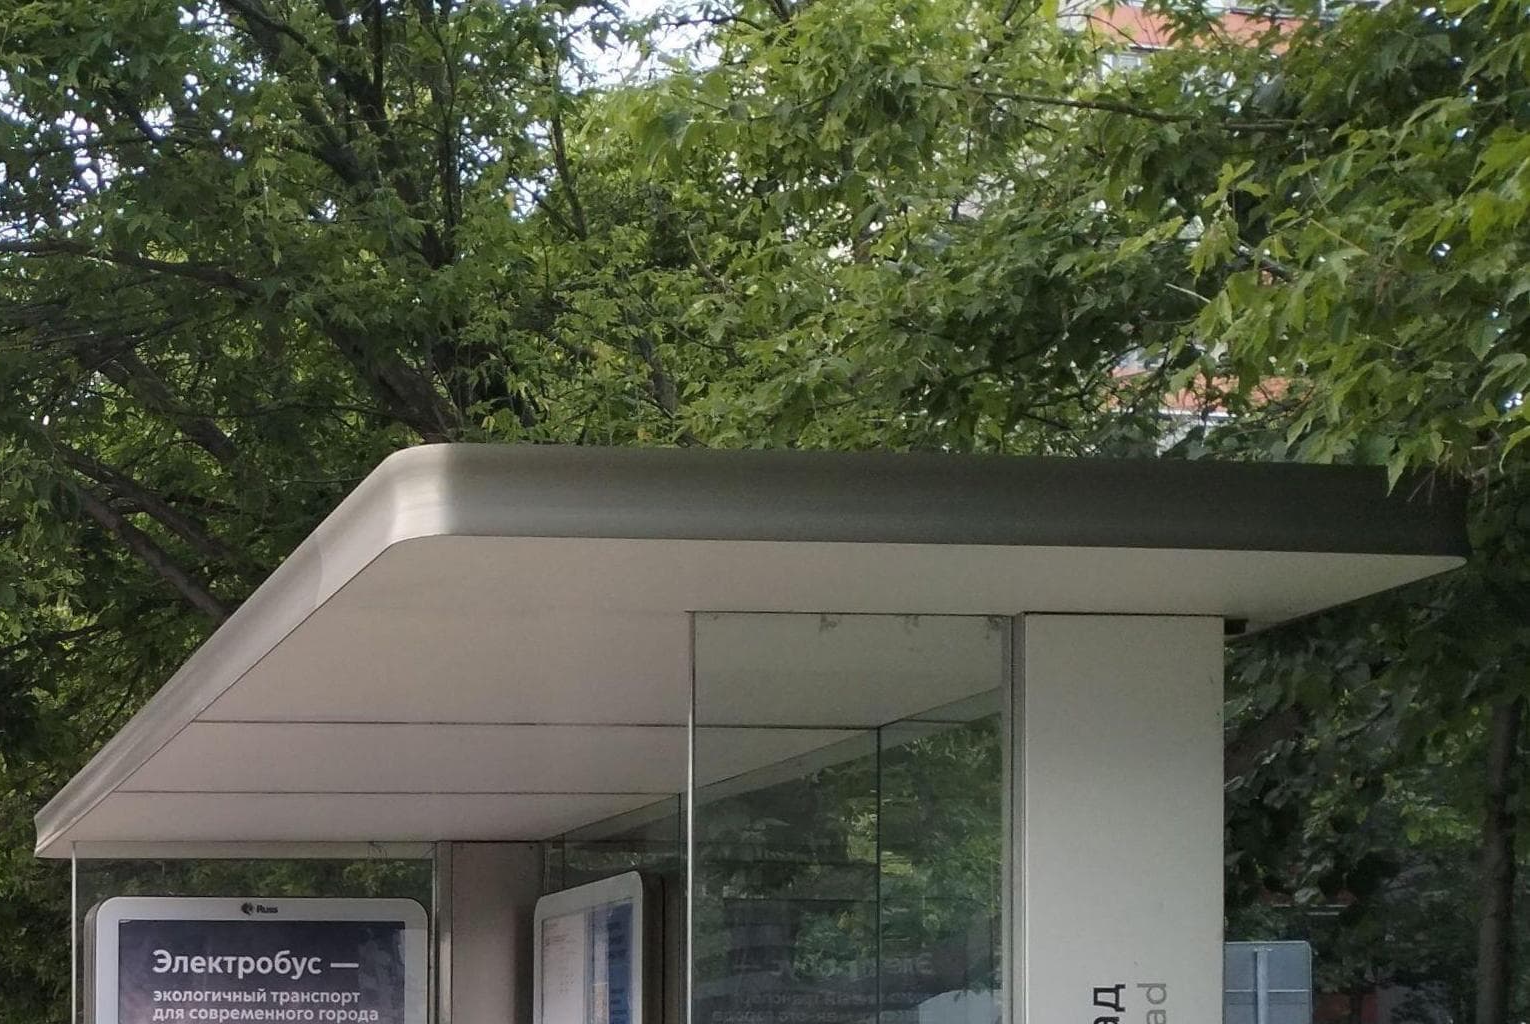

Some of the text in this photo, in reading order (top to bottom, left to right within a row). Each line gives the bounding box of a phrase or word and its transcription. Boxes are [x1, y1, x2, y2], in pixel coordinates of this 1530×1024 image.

[152, 949, 321, 979] Электробус
[153, 988, 360, 1005] экологичный транспорт
[153, 1007, 379, 1022] для современного города
